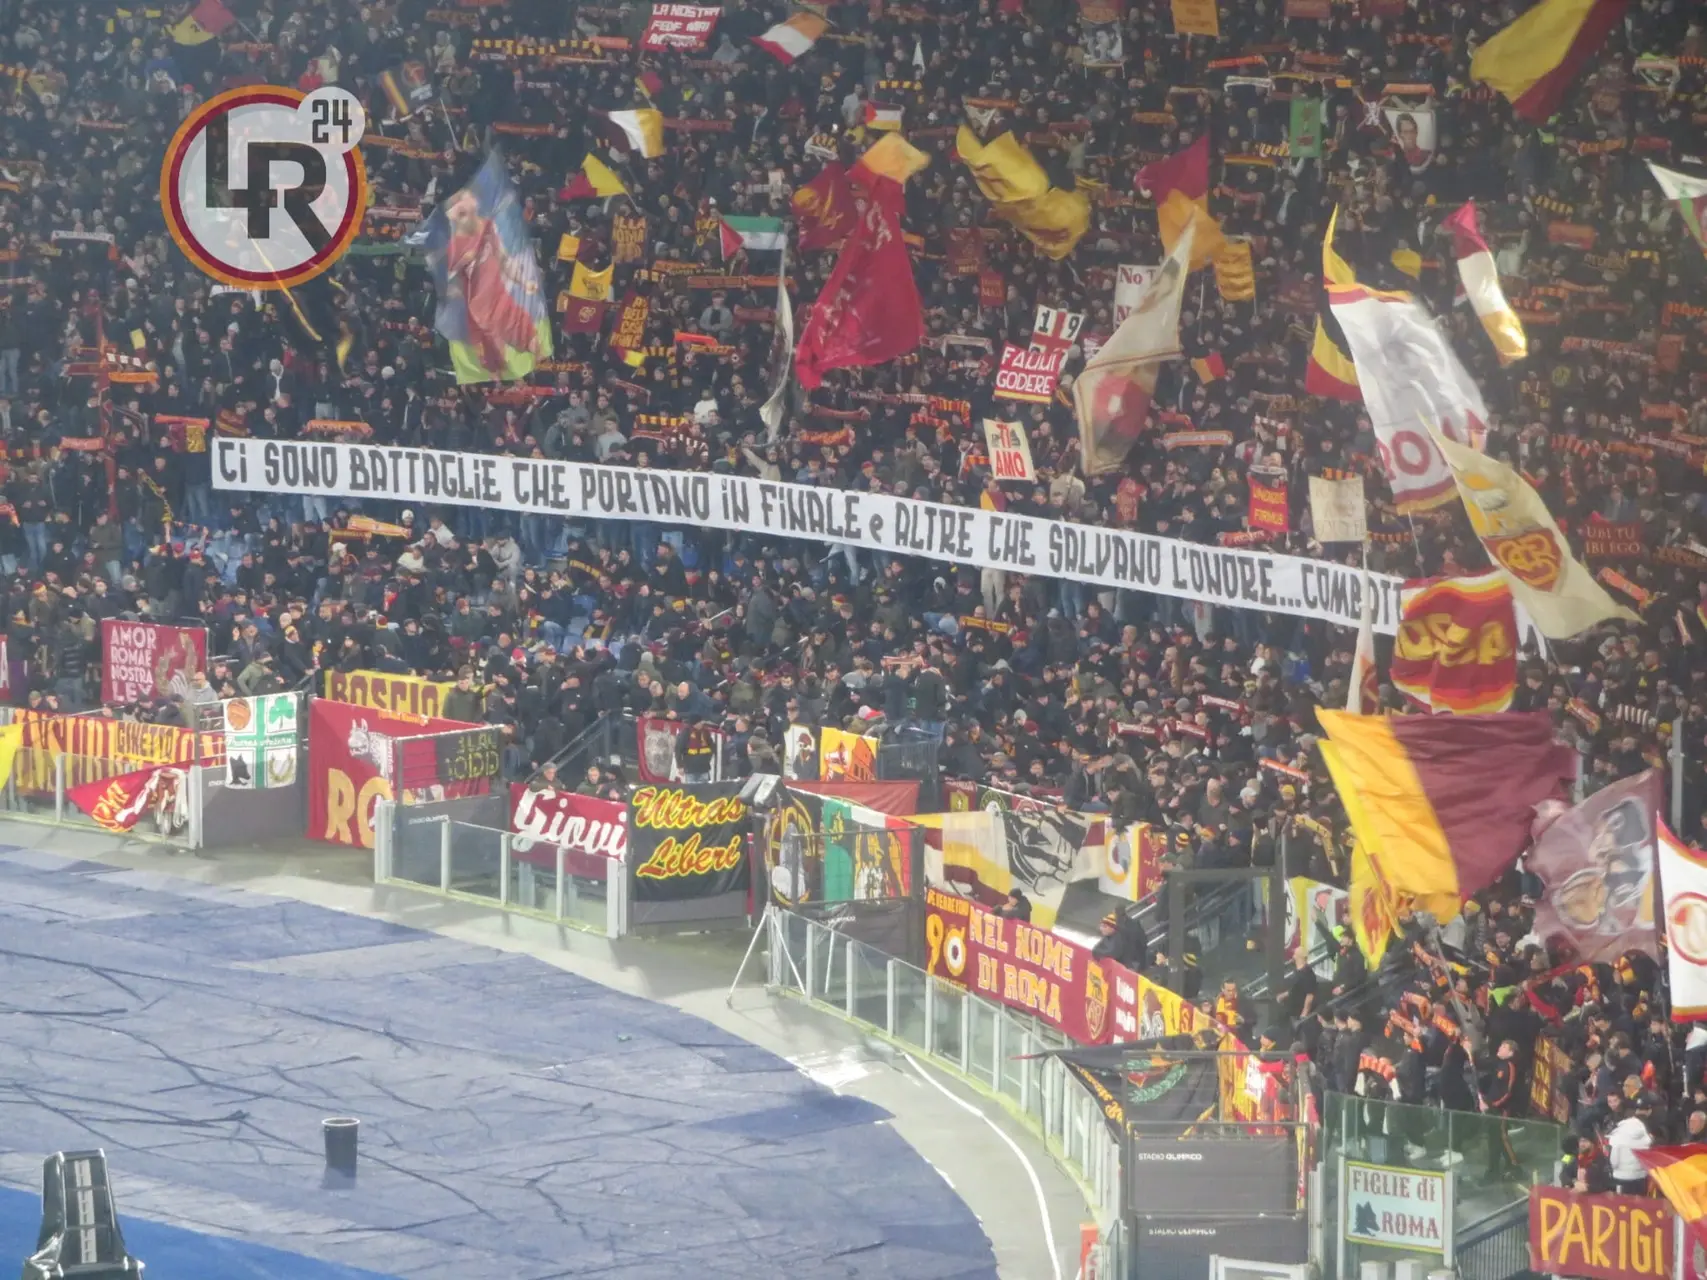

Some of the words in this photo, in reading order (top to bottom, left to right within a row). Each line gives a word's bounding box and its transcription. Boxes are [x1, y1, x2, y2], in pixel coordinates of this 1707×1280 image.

[1120, 266, 1143, 285] No
[996, 370, 1056, 394] GODERE
[995, 450, 1027, 478] AMO
[263, 442, 338, 488] SONO
[511, 462, 570, 510] CHE
[577, 467, 710, 521] PORTANO
[894, 501, 975, 557] ALTRE
[988, 516, 1036, 566] CHE
[1049, 523, 1161, 587] SALVANO
[1615, 527, 1636, 540] TU
[111, 626, 157, 649] AMOR
[110, 646, 153, 666] ROMAE
[111, 663, 154, 685] NOSTRA
[632, 786, 747, 829] Ultras
[636, 832, 742, 880] Liberi
[969, 905, 1008, 953] NEL
[1015, 924, 1074, 982] NOME
[977, 952, 998, 994] DI
[1004, 964, 1062, 1023] ROMA
[1138, 1152, 1165, 1161] STADIO
[1165, 1152, 1203, 1161] OLIMPICO
[1352, 1170, 1410, 1199] FIGLIE
[1417, 1177, 1437, 1202] di
[1381, 1211, 1441, 1240] ROMA
